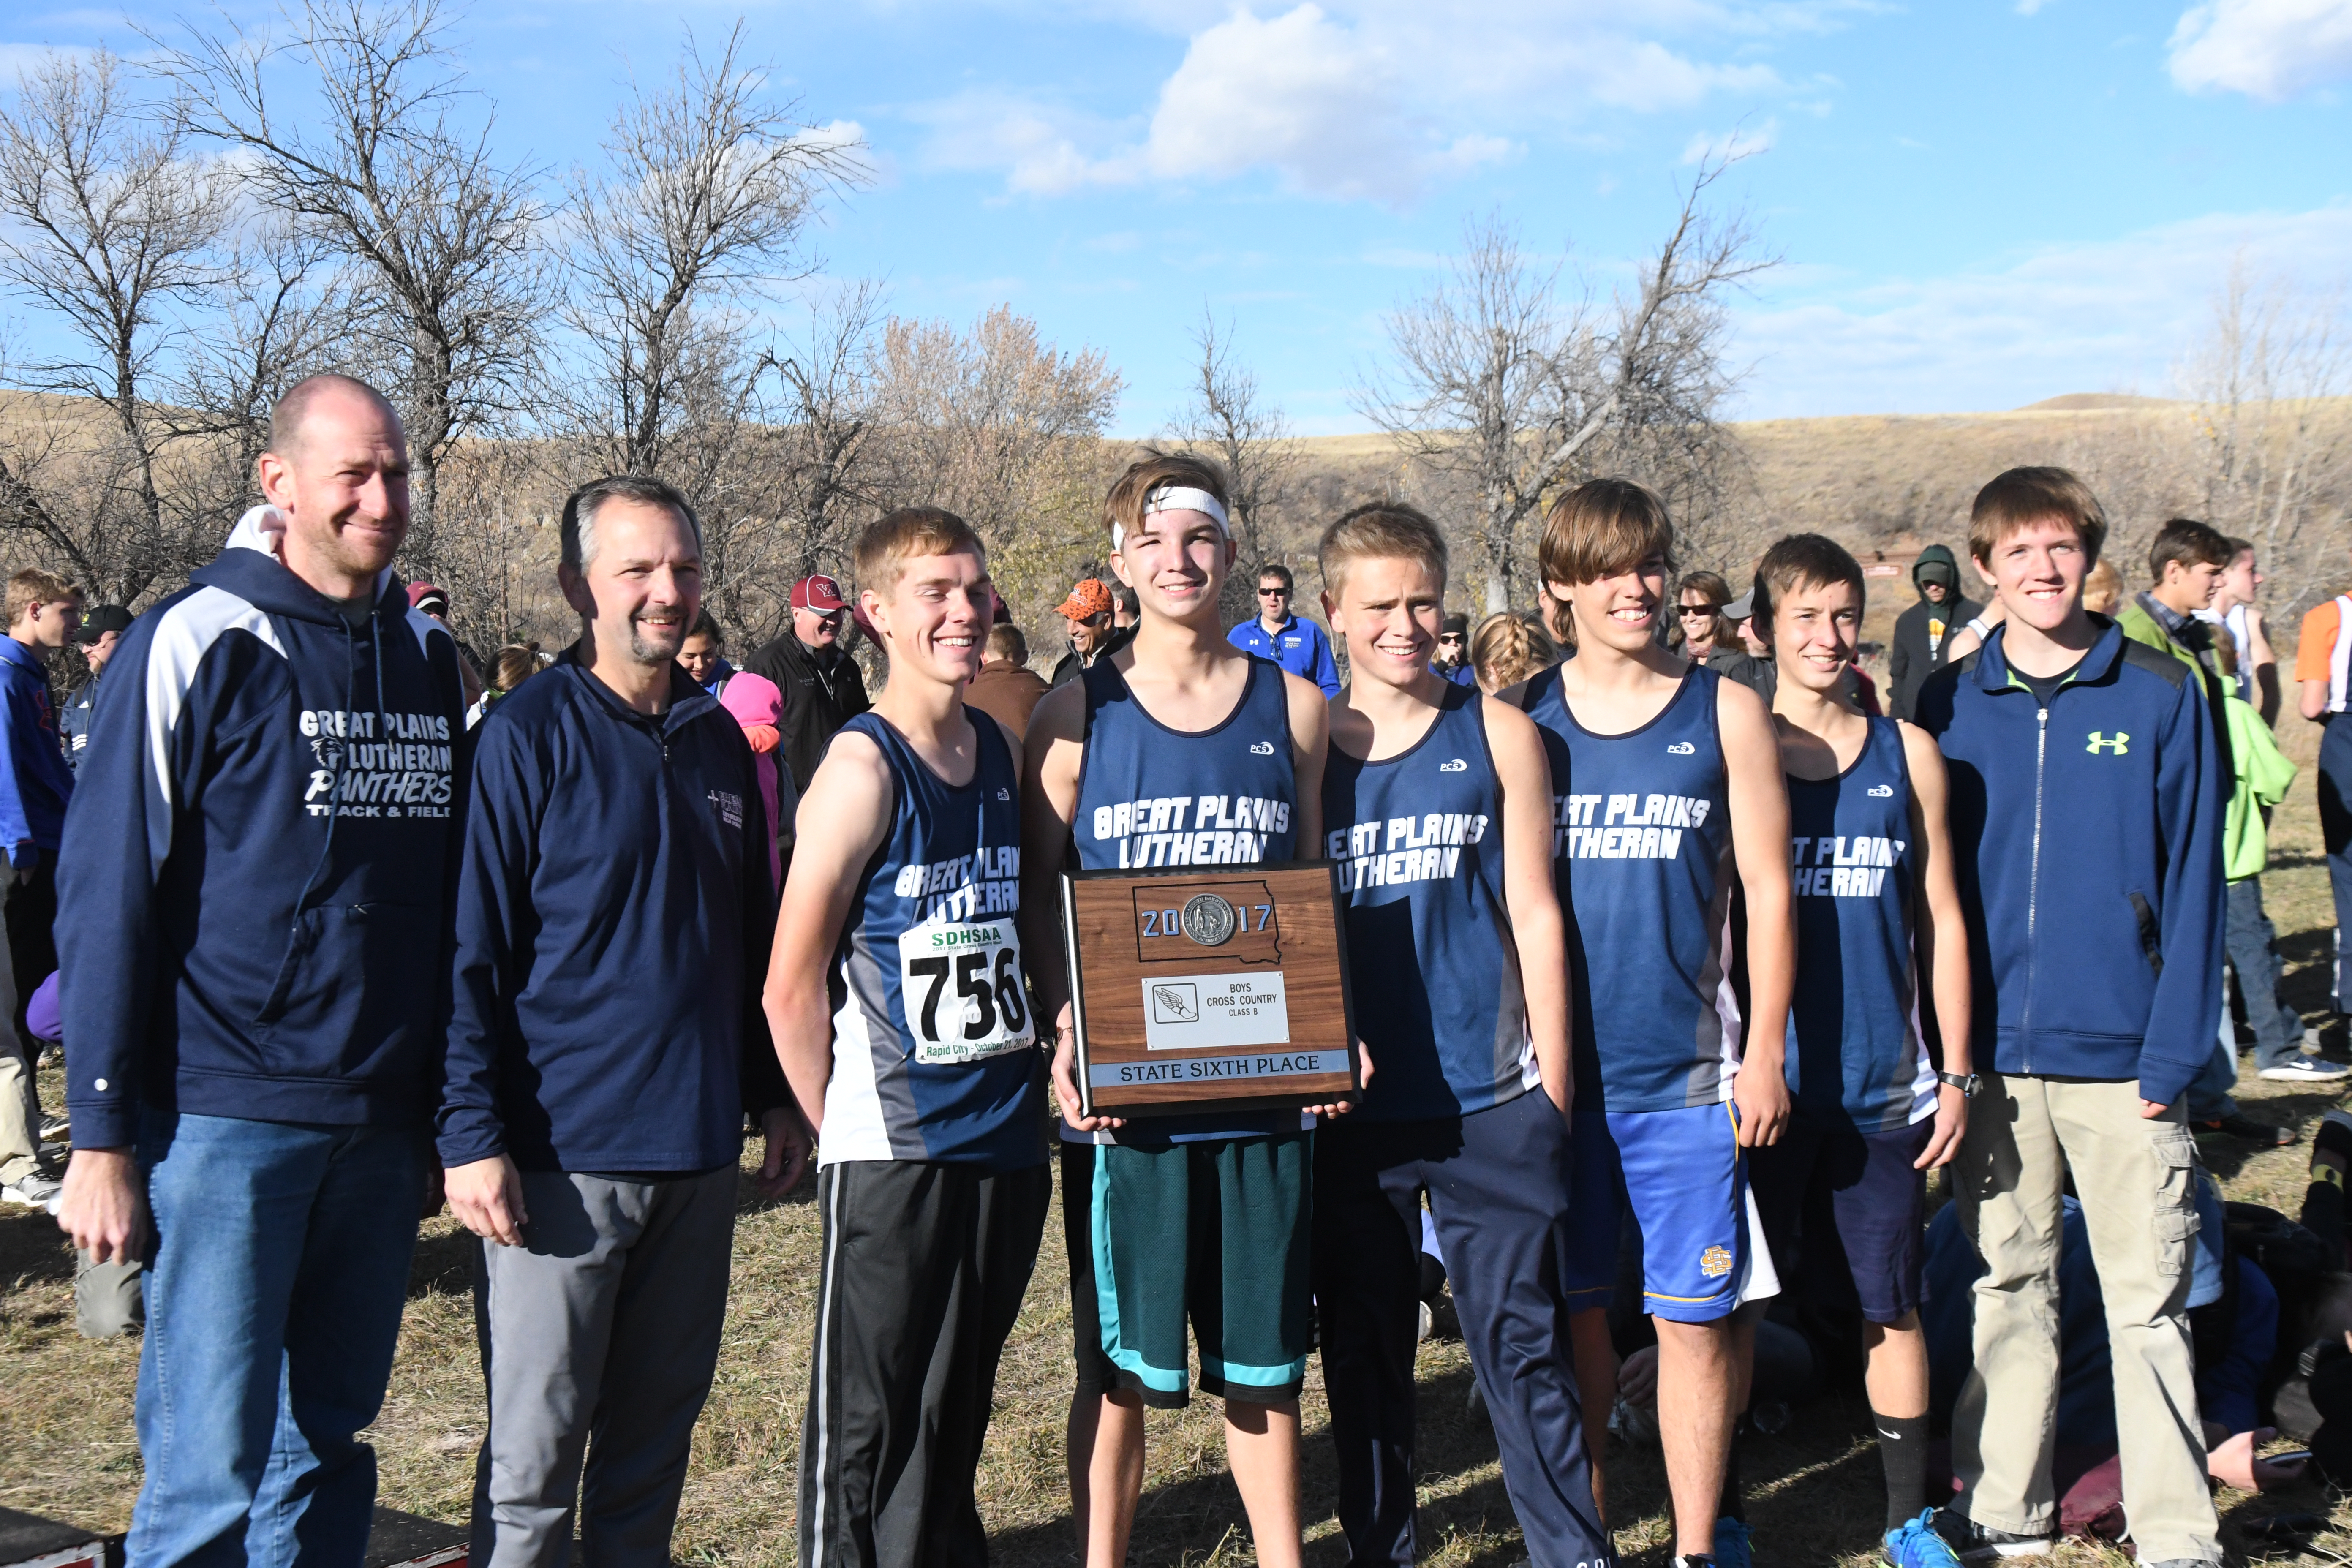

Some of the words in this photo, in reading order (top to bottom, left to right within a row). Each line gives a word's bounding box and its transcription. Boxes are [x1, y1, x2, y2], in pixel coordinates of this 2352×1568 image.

[299, 710, 376, 738] GREAT
[384, 713, 450, 740] PLAINS
[348, 743, 452, 771] LUTHERAN
[304, 770, 452, 804] PANTHERS
[387, 806, 402, 817] &
[1094, 796, 1192, 840] GREAT
[1195, 795, 1290, 833] PLAINS
[1604, 794, 1711, 828] PLAINS
[1119, 831, 1268, 869] LUTHERAN
[1324, 821, 1381, 859] EAT
[1386, 813, 1489, 851] PLAINS
[1554, 827, 1682, 860] THERAN
[894, 854, 972, 897] GREAT
[1338, 847, 1461, 894] UTHERAN
[1794, 867, 1886, 897] HERAN
[910, 880, 1019, 929] LUTHERAN
[1142, 909, 1180, 937] 20
[1239, 904, 1271, 932] 17
[932, 927, 1002, 946] SDHSAA
[909, 947, 1026, 1042] 756
[1207, 996, 1235, 1007] CROSS
[1239, 994, 1277, 1005] COUNTRY
[1230, 983, 1252, 993] BOYS
[926, 1045, 950, 1058] Rapid
[953, 1045, 968, 1055] City
[975, 1042, 1003, 1052] October
[1003, 1040, 1012, 1050] 21,
[1014, 1037, 1029, 1048] 2017
[1121, 1064, 1183, 1081] STATE
[1190, 1059, 1249, 1078] SIXTH
[1257, 1055, 1320, 1073] PLACE
